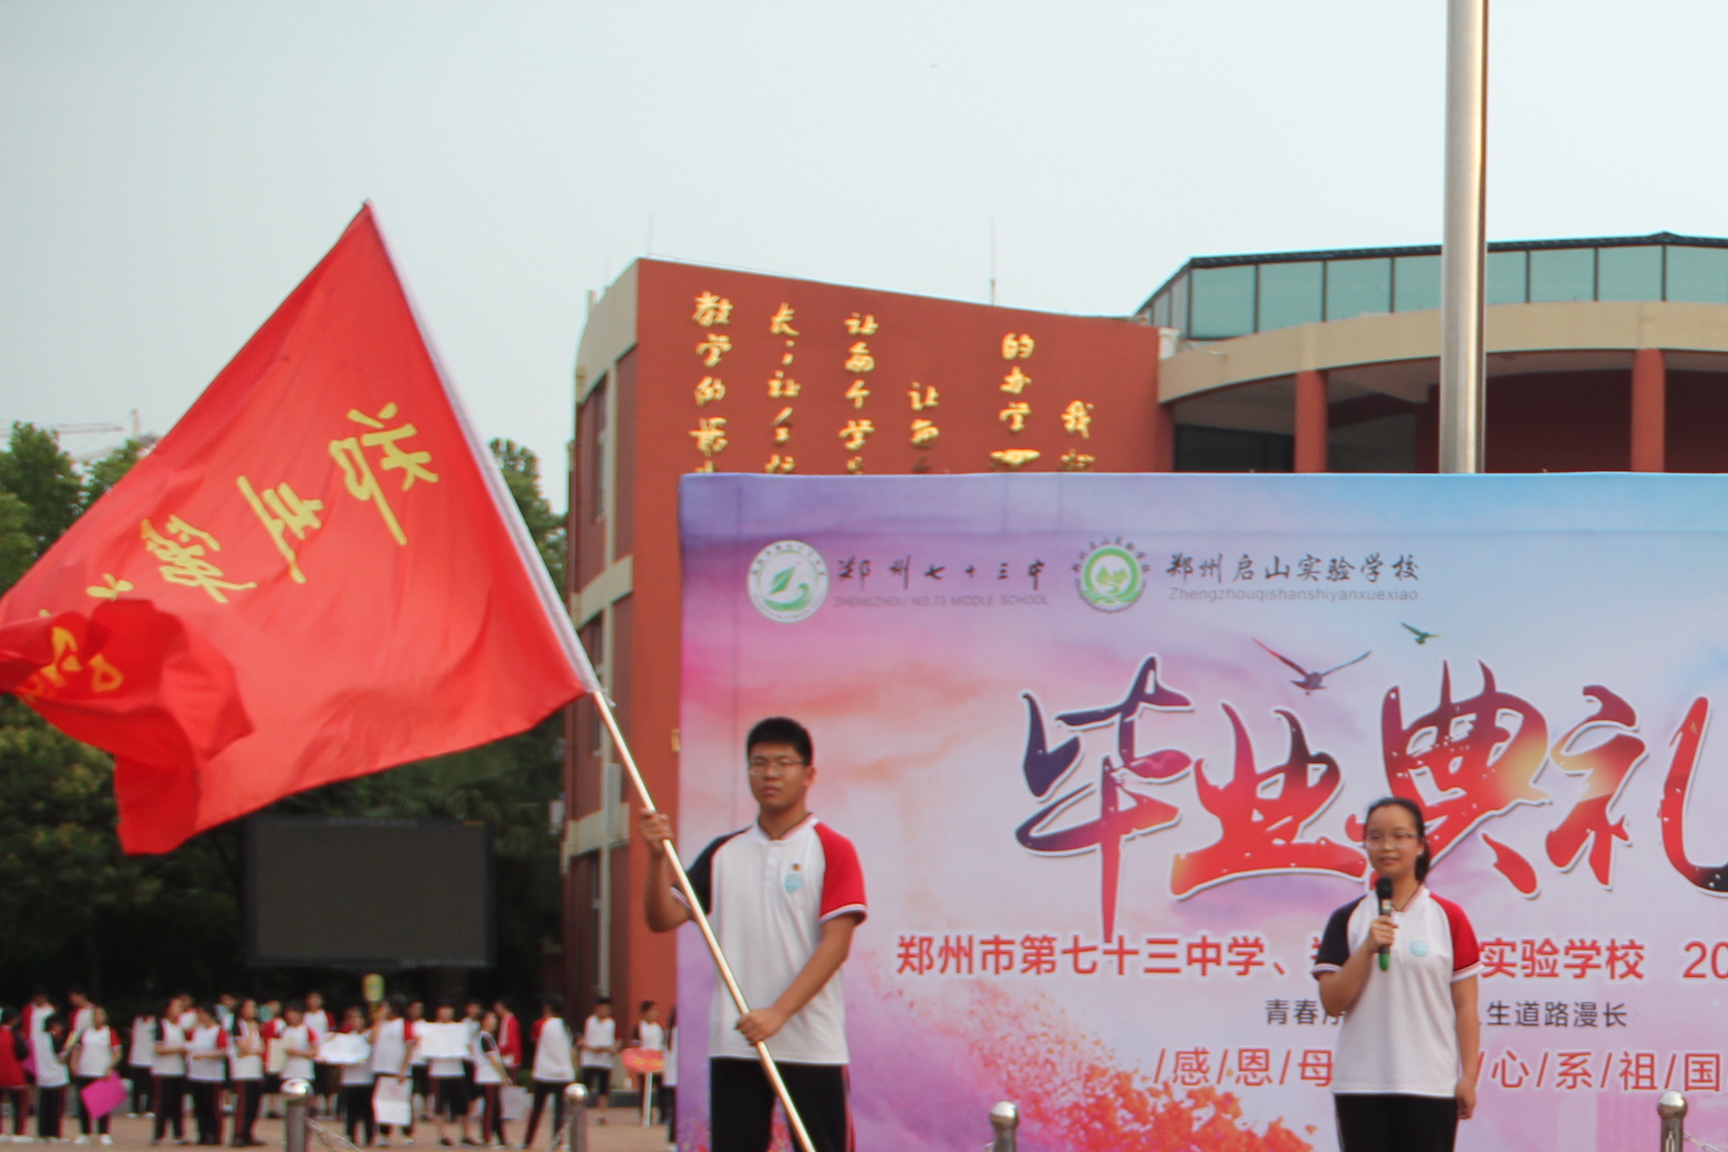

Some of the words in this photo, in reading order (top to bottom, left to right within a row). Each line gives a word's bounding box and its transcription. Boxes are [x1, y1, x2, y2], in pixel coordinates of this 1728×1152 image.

[837, 555, 1047, 592] 郑州七十三中
[1164, 552, 1420, 584] 郑州启山实验学校
[1484, 999, 1628, 1028] 生道路漫长
